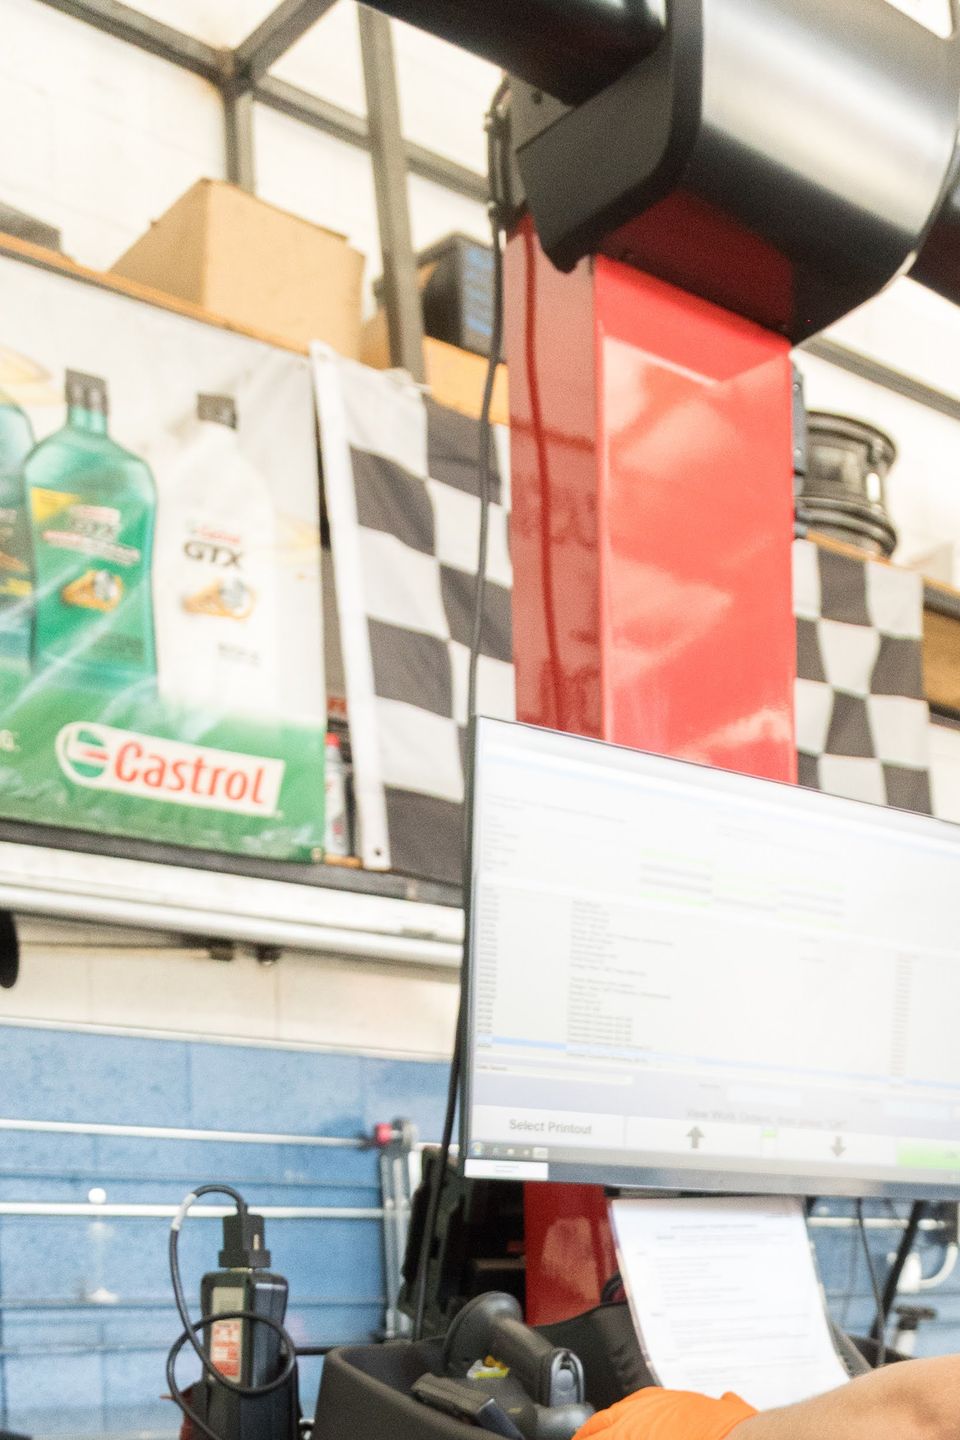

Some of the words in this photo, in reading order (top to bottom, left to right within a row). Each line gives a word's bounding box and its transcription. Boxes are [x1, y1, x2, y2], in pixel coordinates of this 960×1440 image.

[183, 540, 243, 569] GTX
[115, 741, 265, 804] Castrol
[509, 1118, 544, 1132] Select
[548, 1121, 592, 1135] Printout
